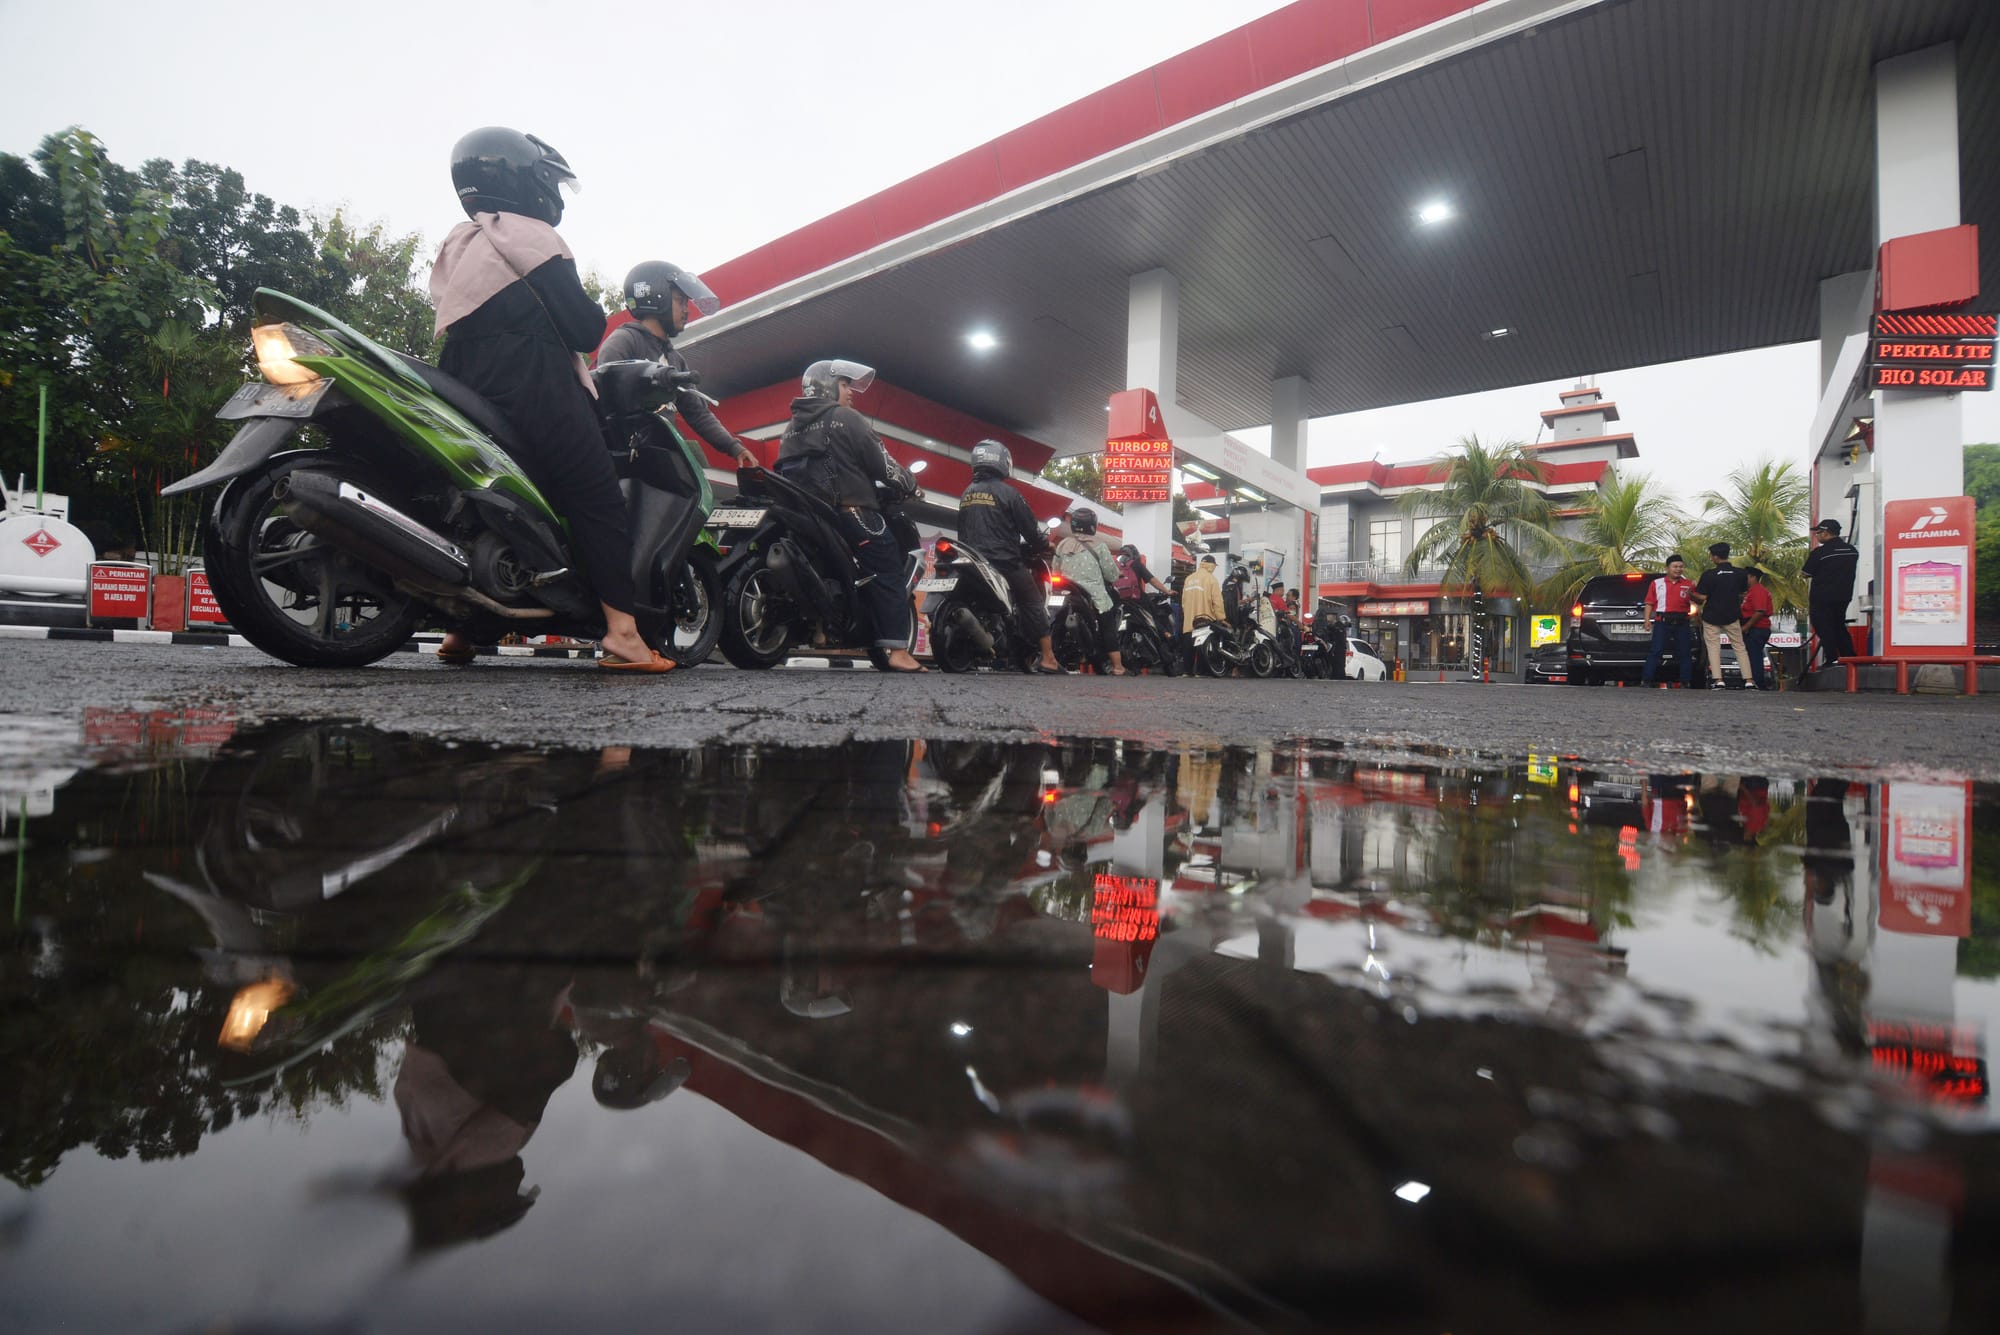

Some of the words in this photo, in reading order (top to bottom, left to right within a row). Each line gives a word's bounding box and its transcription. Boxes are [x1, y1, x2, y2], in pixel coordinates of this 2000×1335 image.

[1879, 344, 1992, 358] PERTALITE
[1878, 369, 1915, 385] BIO
[1919, 370, 1986, 386] SOLAR
[1149, 406, 1157, 424] 4
[1108, 441, 1150, 452] TURBO
[1153, 441, 1168, 452] 98
[1105, 457, 1171, 468] PERTAMAX
[1107, 474, 1168, 483] PERTALITE
[1106, 490, 1167, 500] DEXLITE
[1898, 529, 1960, 540] PERTAMINA
[109, 570, 145, 579] PERHATIAN
[93, 582, 118, 591] DILARANG
[118, 583, 146, 593] BERJUALAN
[110, 593, 123, 601] AREA
[123, 594, 137, 602] SPBU
